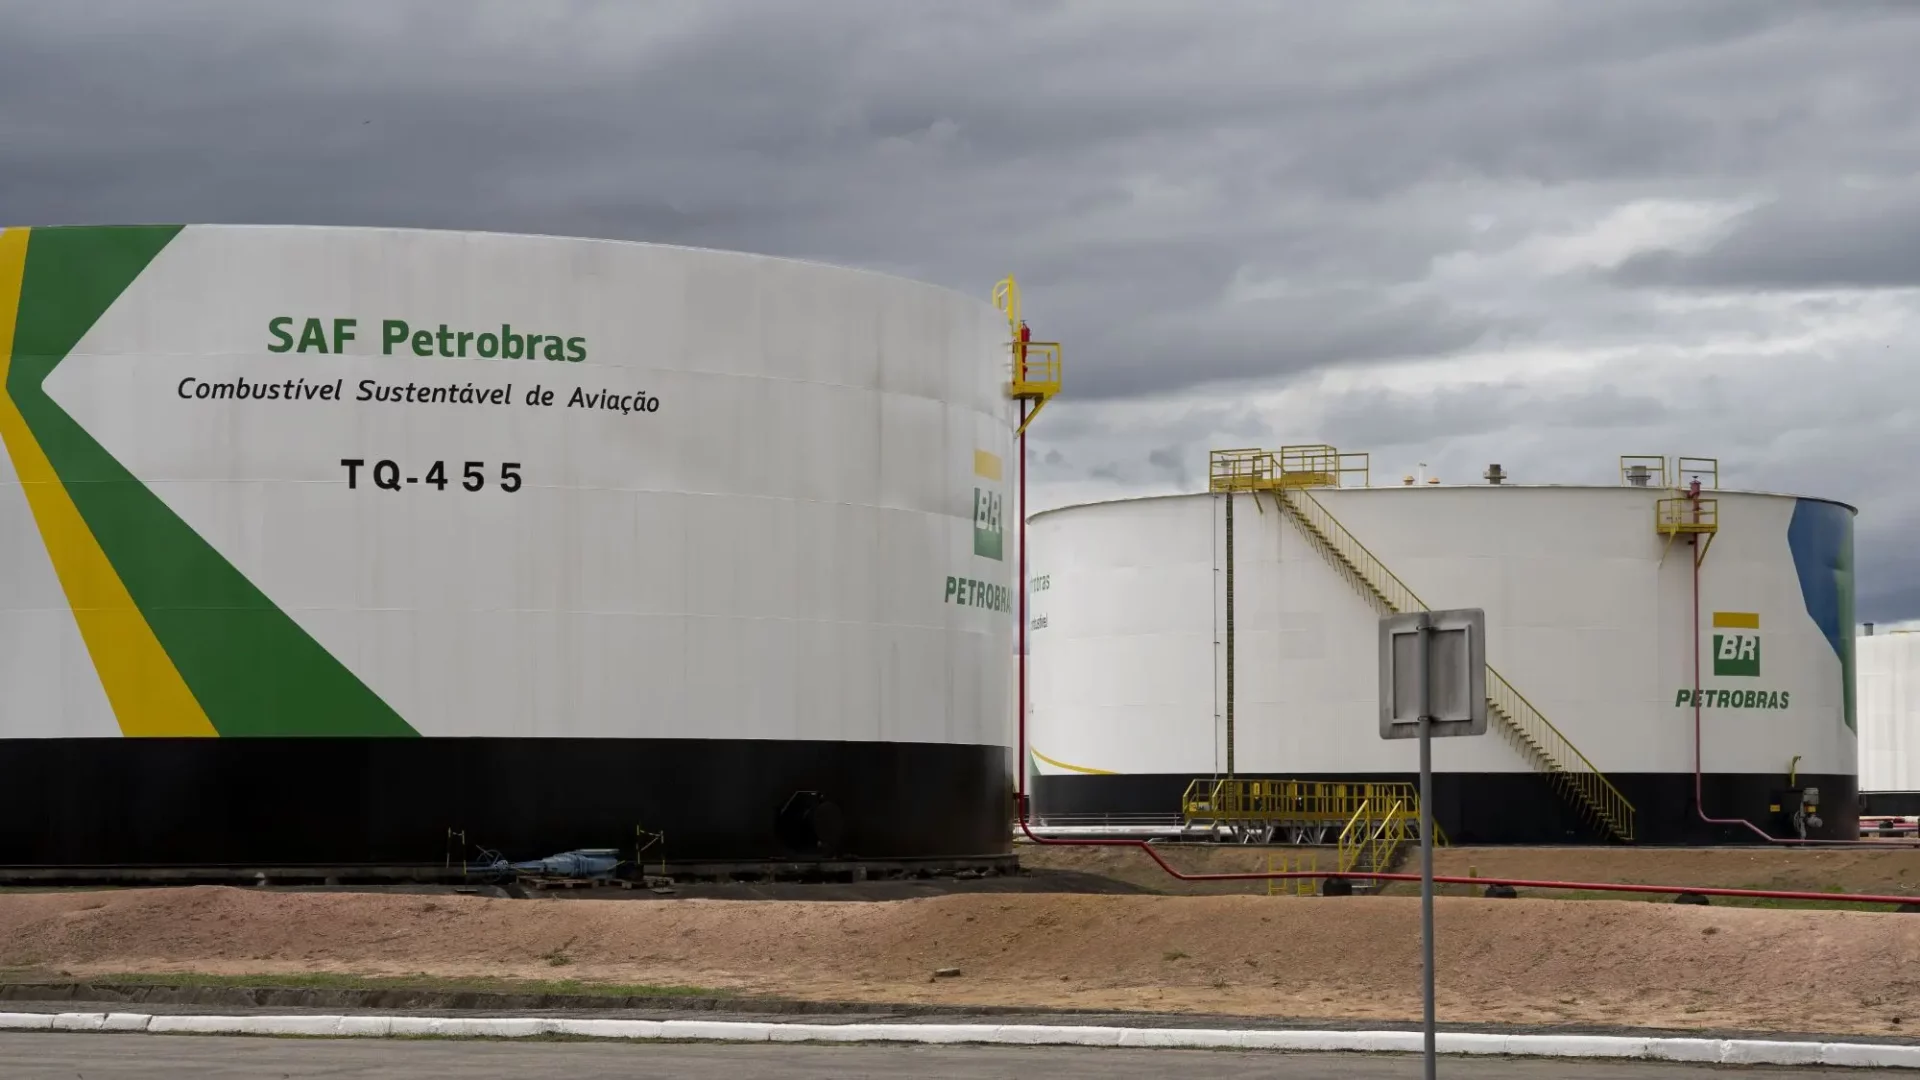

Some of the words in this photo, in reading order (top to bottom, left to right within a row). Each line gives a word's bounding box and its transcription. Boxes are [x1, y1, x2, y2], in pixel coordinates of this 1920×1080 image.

[267, 316, 357, 354] SAF
[382, 319, 588, 362] Petrobras
[177, 376, 343, 401] Combustível
[355, 379, 512, 405] Sustentável
[525, 384, 555, 407] de
[567, 386, 660, 416] Aviação
[976, 487, 1001, 534] BR
[944, 575, 1013, 615] PETROBRA
[1718, 634, 1757, 660] BR
[1675, 688, 1790, 710] PETROBRAS
